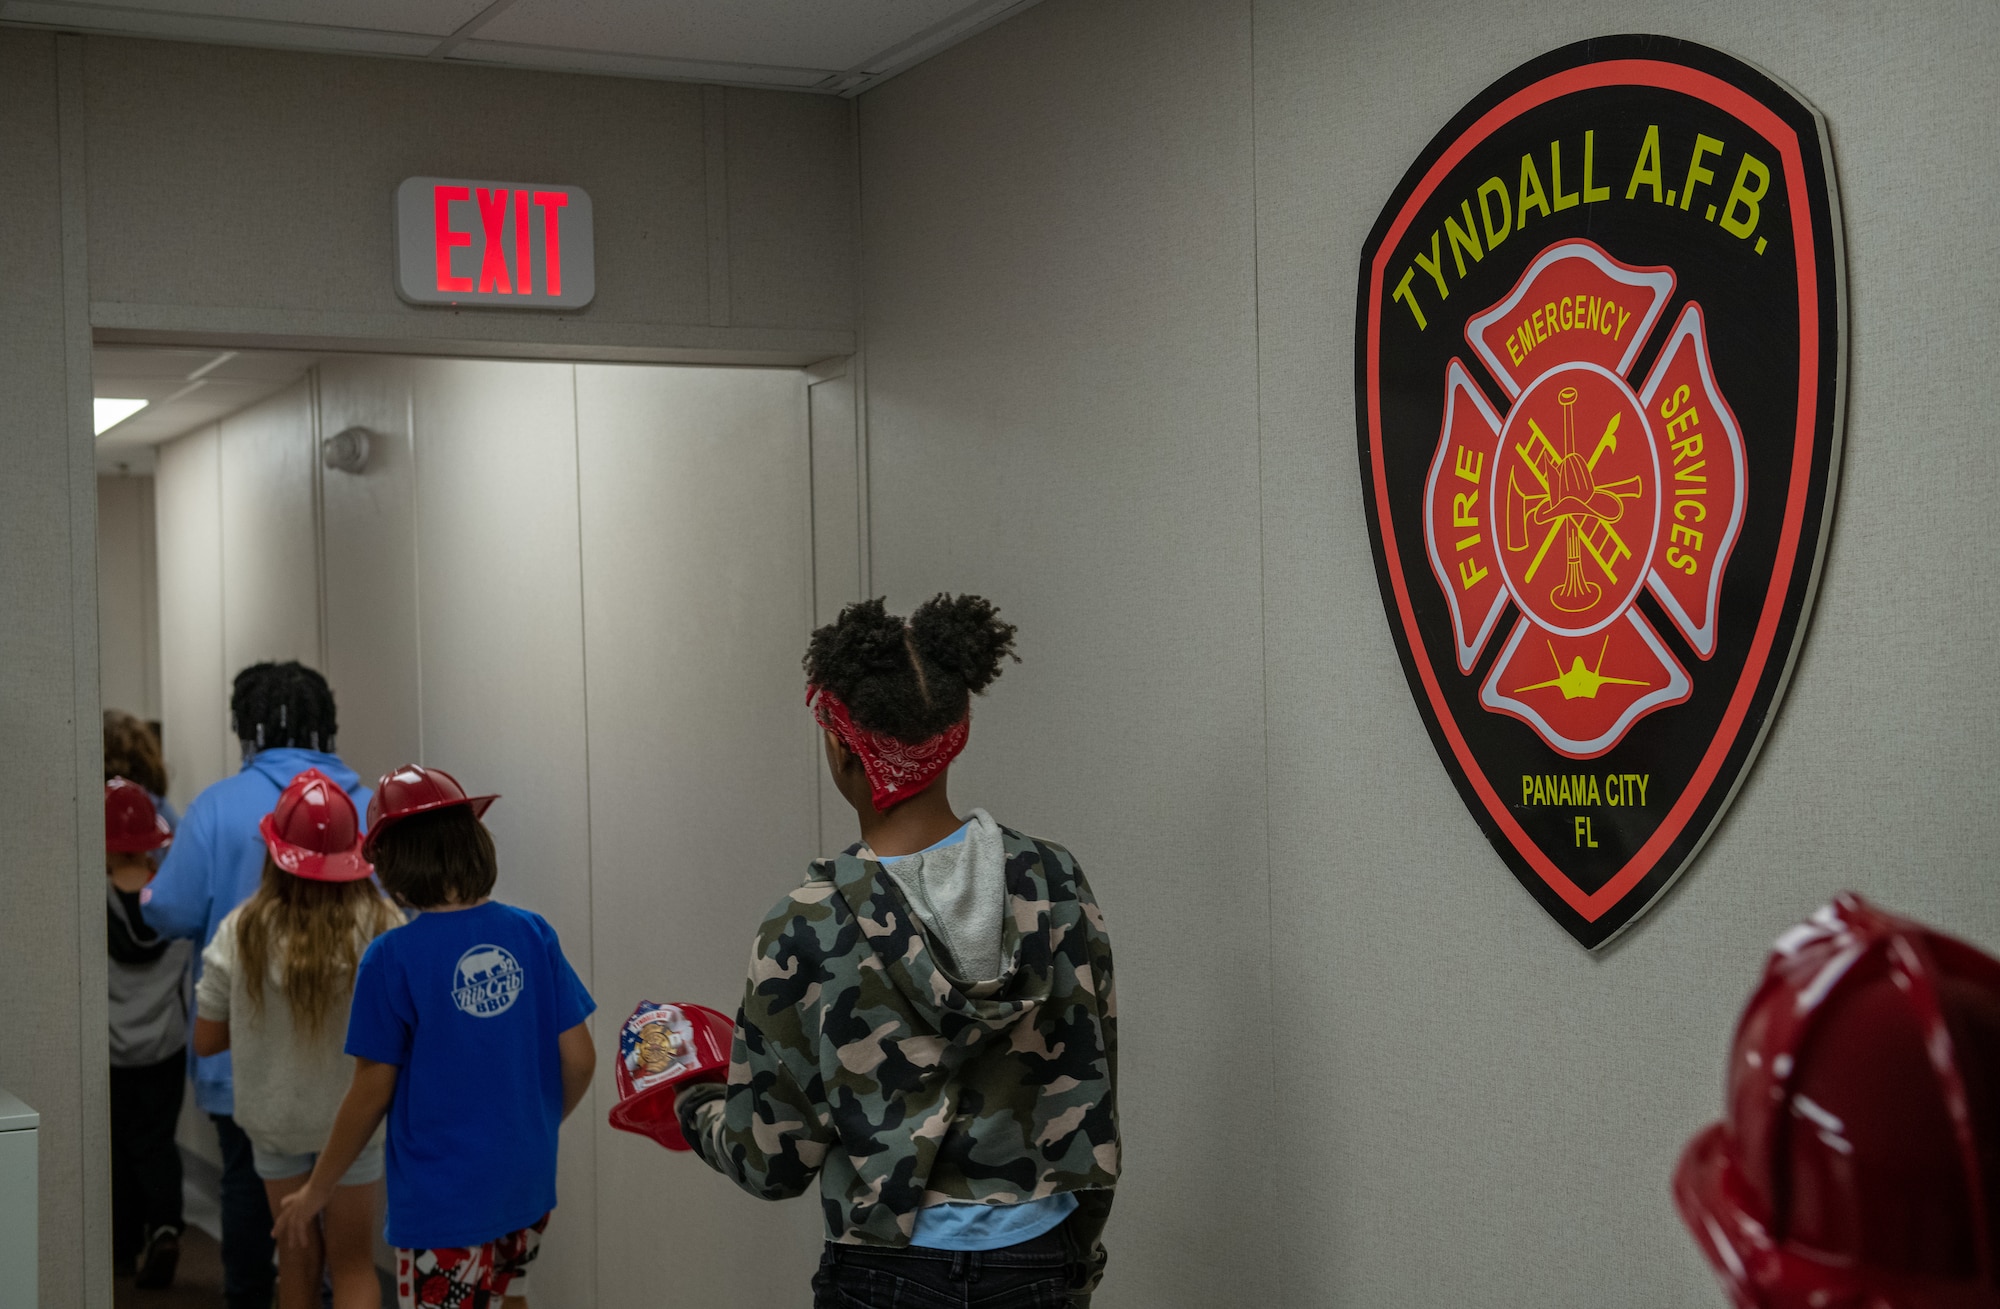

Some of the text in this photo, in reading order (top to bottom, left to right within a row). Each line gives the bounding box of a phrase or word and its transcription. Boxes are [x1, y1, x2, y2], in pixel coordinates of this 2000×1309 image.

[434, 185, 569, 297] EXIT
[1392, 124, 1771, 332] TYNDALL A.F.B.
[1506, 294, 1631, 367] EMERGENCY
[1453, 445, 1488, 590] FIRE
[1660, 384, 1708, 575] SERVICES
[1522, 774, 1650, 807] PANAMA CITY
[1575, 816, 1599, 848] FL
